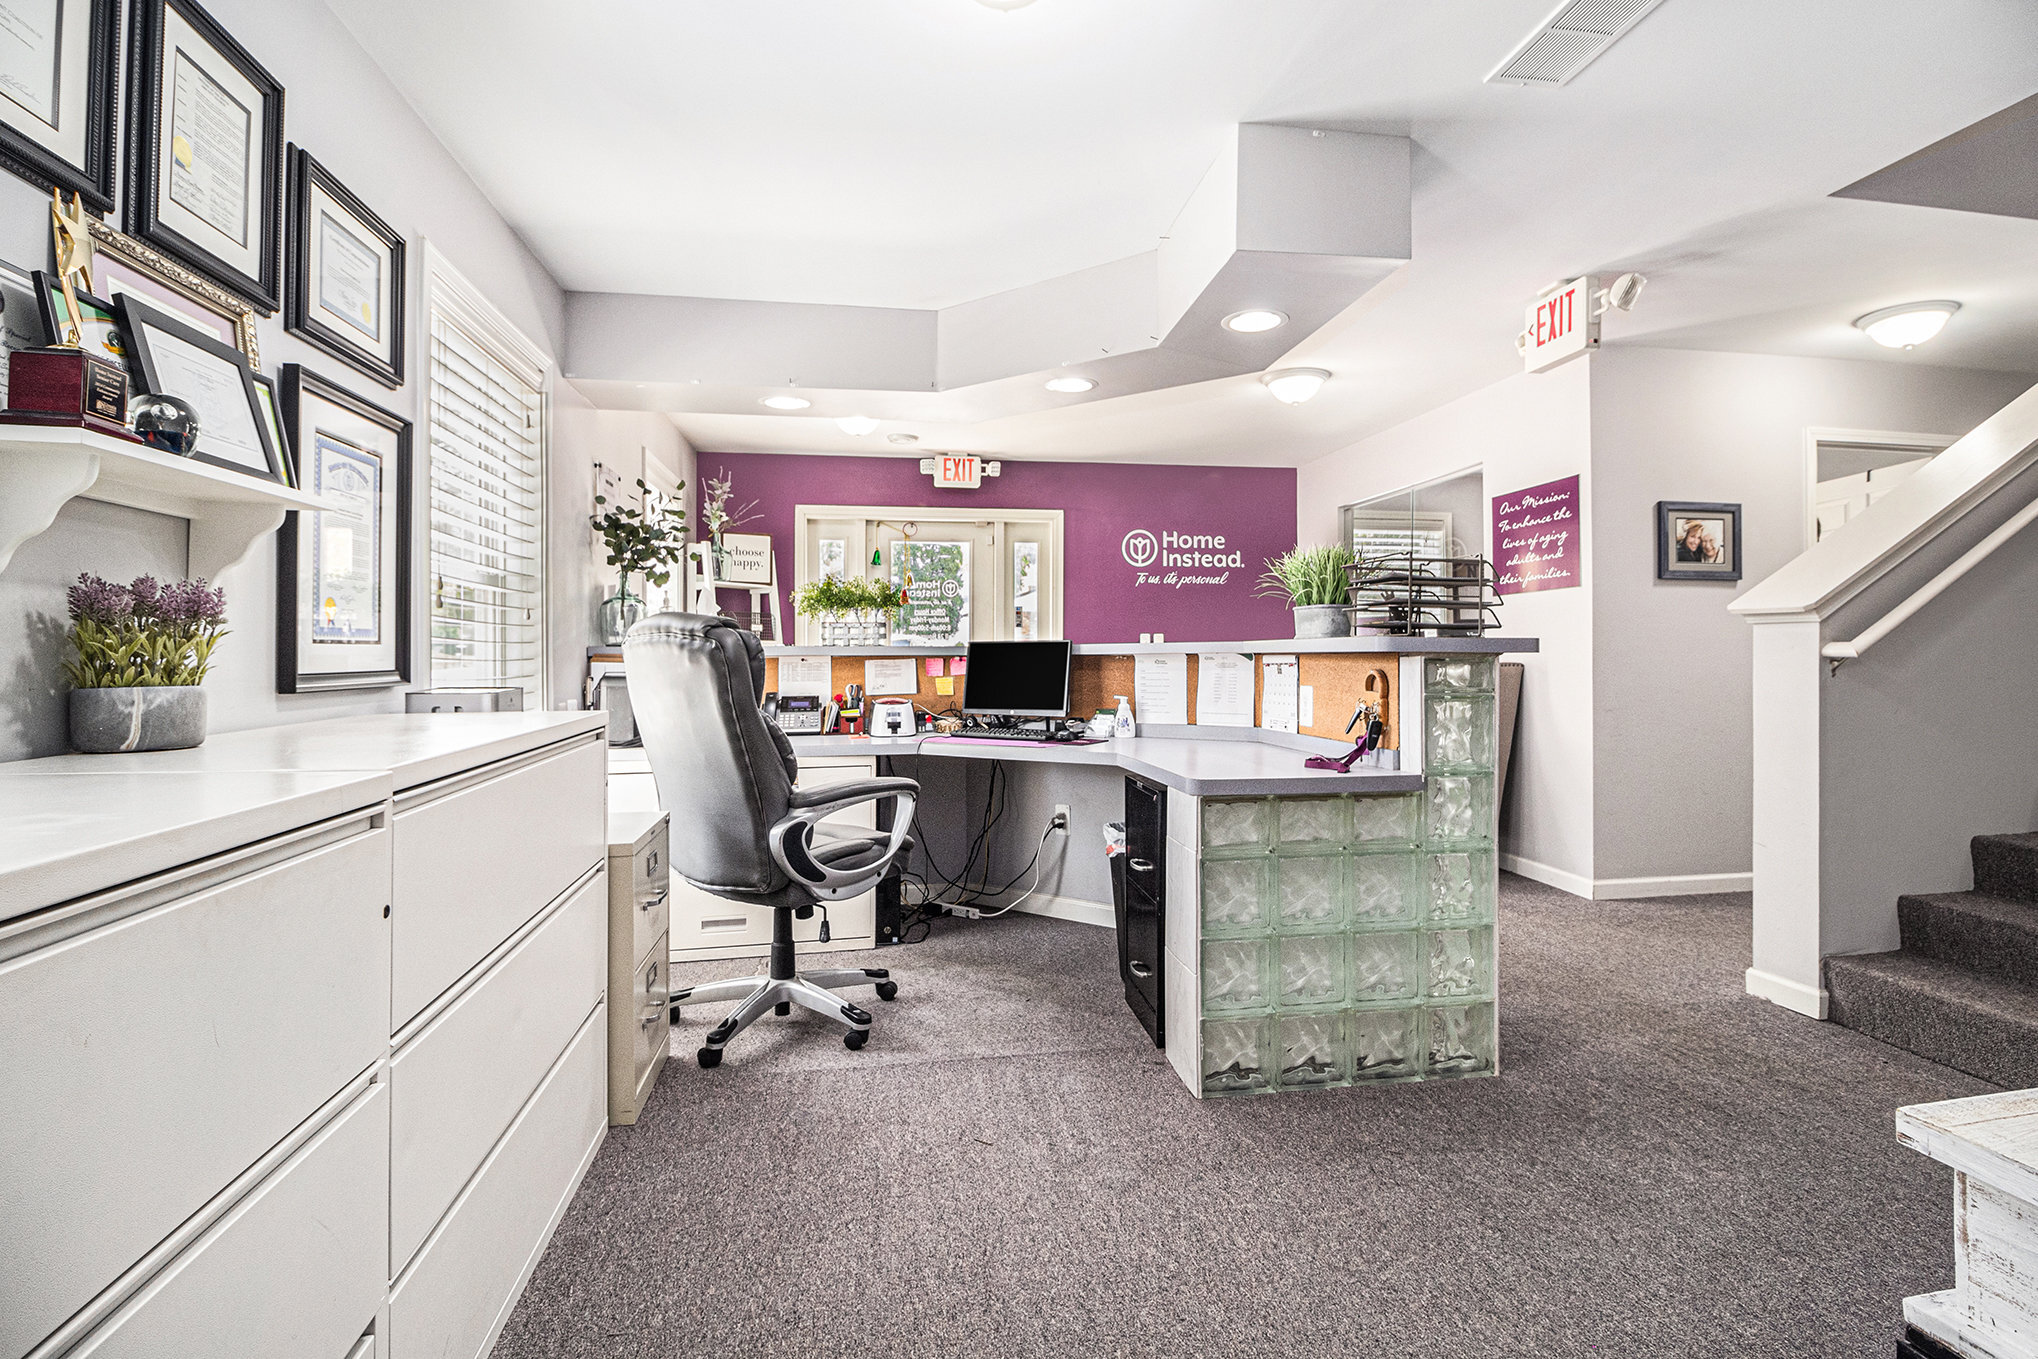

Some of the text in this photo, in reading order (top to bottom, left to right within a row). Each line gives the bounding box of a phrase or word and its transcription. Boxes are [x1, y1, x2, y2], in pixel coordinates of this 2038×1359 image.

[1537, 288, 1575, 348] EXIT
[943, 457, 975, 482] EXIT
[1499, 492, 1571, 515] Our Mission:
[1498, 506, 1573, 533] To enhance the
[1162, 530, 1226, 549] Home
[1502, 530, 1569, 551] lives of aging
[1162, 549, 1246, 568] Instead.
[1506, 546, 1565, 566] adults and
[1135, 570, 1230, 589] To us, it's personal
[1499, 567, 1571, 588] their families.
